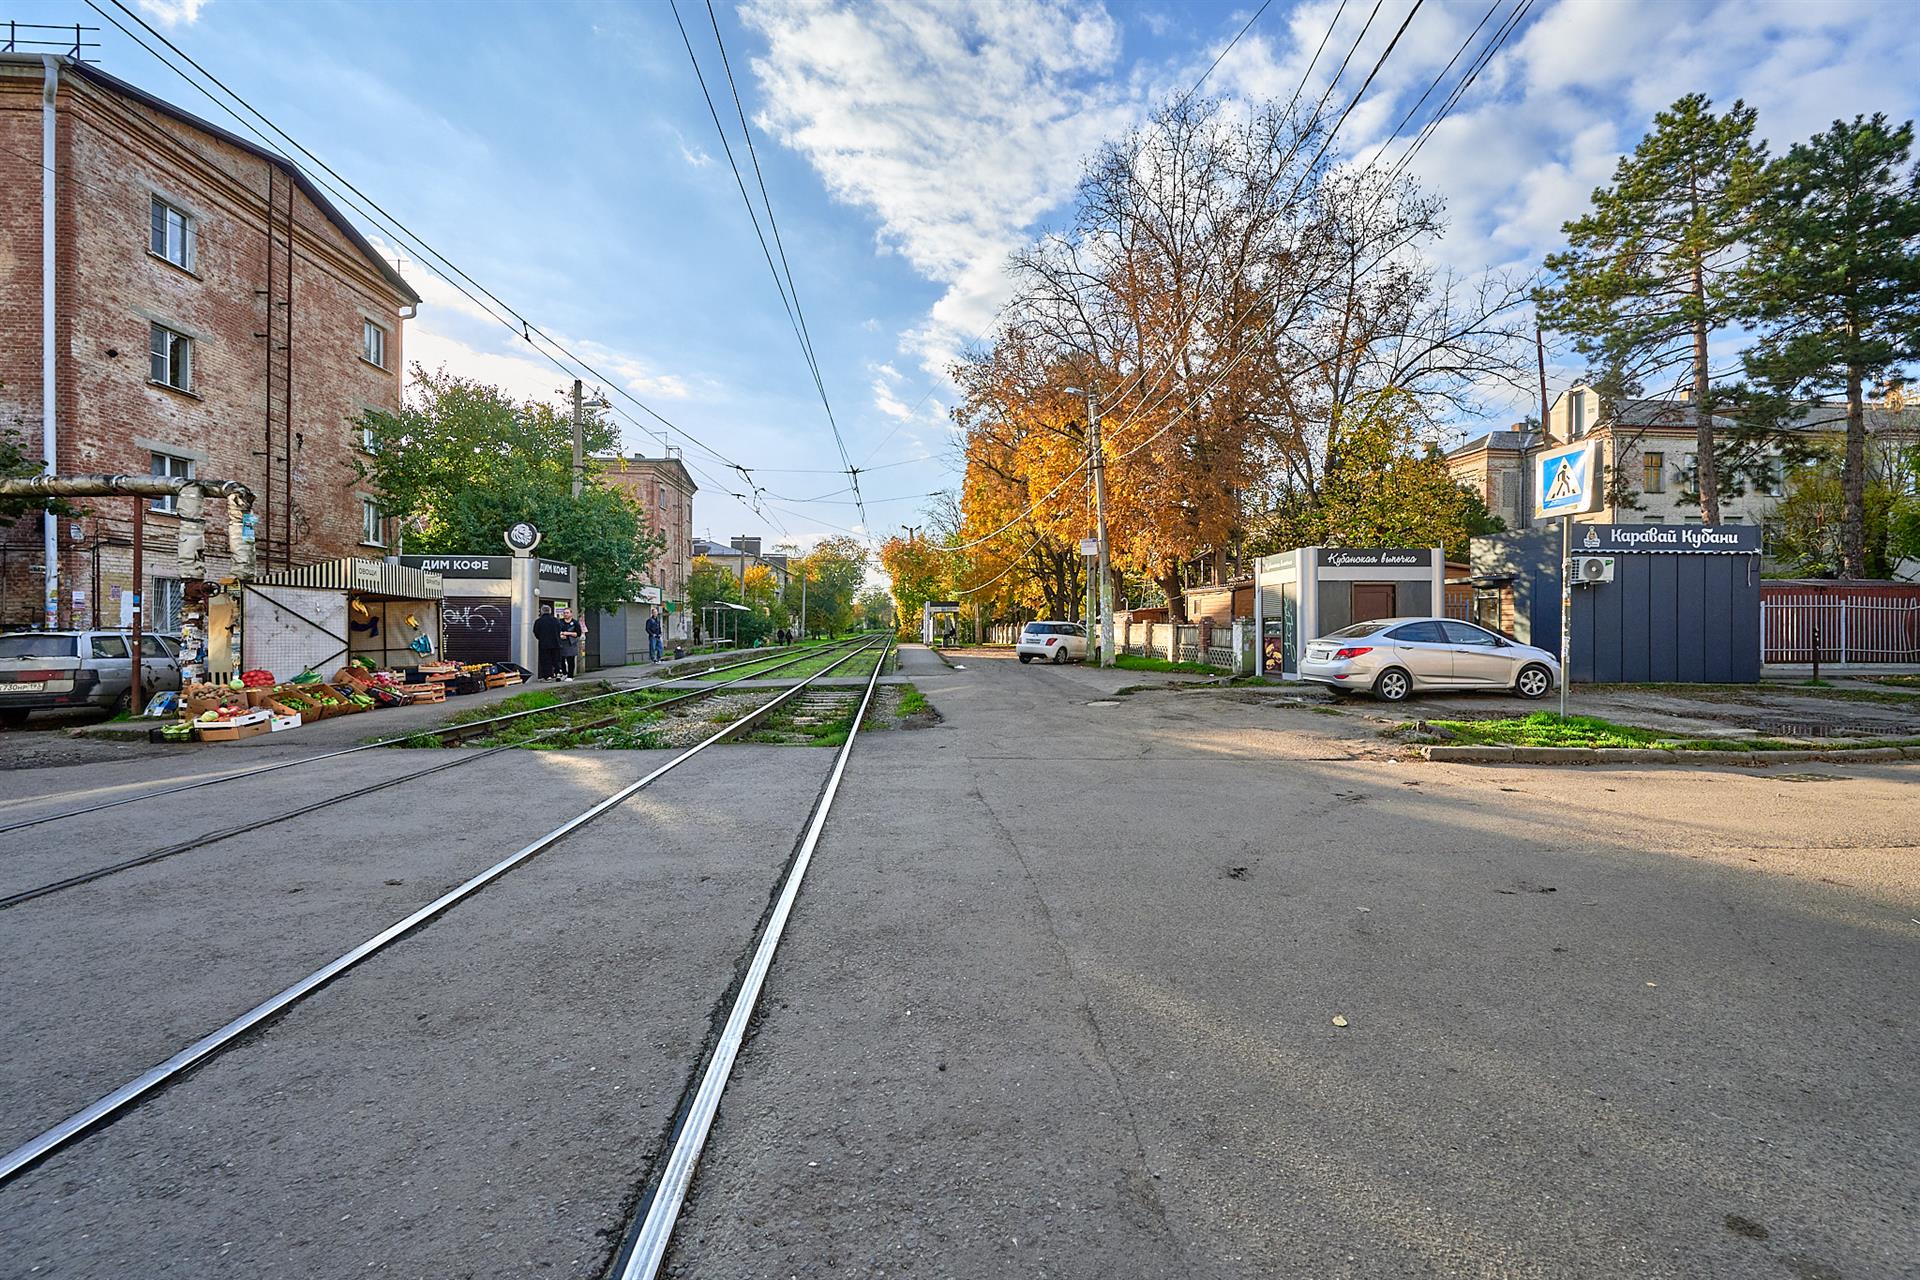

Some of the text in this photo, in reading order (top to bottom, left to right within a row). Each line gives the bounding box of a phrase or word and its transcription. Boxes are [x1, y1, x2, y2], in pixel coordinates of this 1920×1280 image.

[1611, 527, 1739, 548] Каравай Кубани
[421, 560, 489, 570] ДИМ КОФЕ
[1327, 552, 1417, 567] Кубанская выпечка
[358, 567, 377, 577] ОВОЩИ
[539, 562, 568, 576] ДИМ КОФЕ
